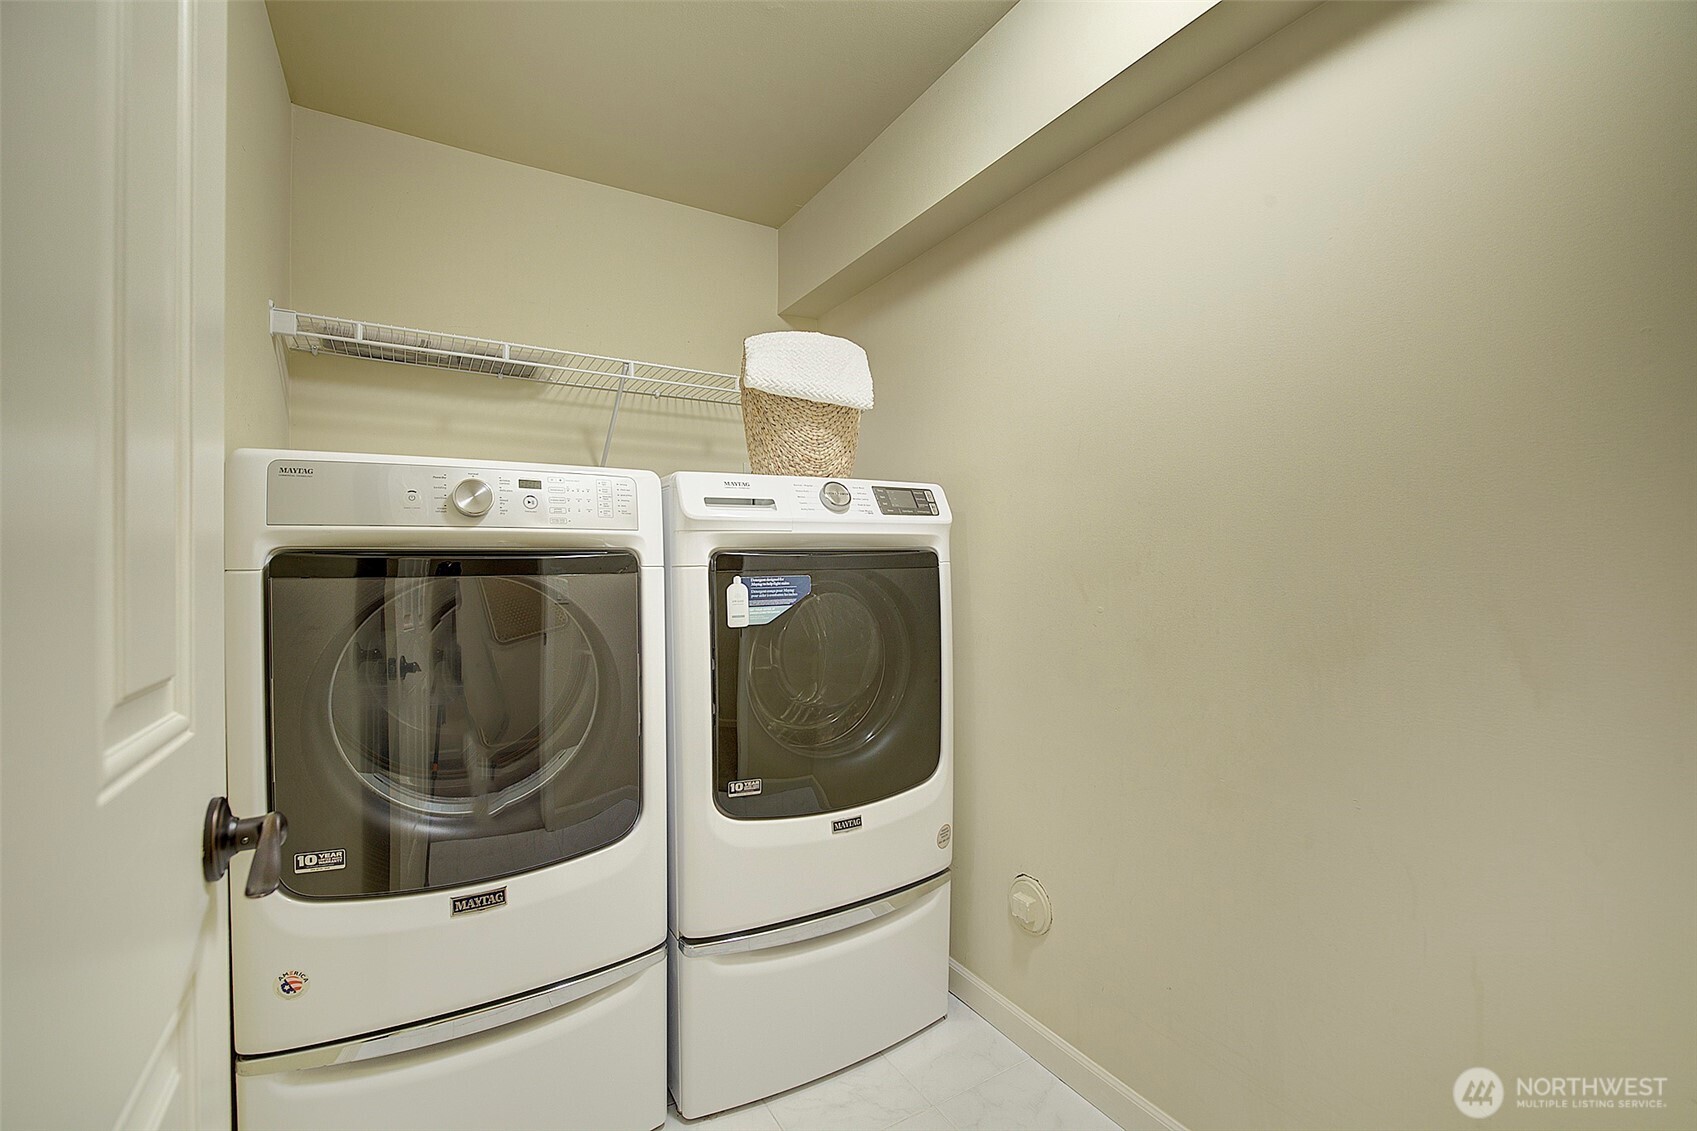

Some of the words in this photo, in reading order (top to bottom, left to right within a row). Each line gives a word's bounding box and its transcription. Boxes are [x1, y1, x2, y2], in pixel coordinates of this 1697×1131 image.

[279, 467, 314, 475] MAYTAG
[730, 782, 744, 793] 10
[834, 818, 861, 831] MAYTAG
[297, 854, 318, 867] 10
[318, 851, 343, 859] YEAR
[454, 892, 504, 912] MAYTAG
[278, 970, 309, 983] AMERICA
